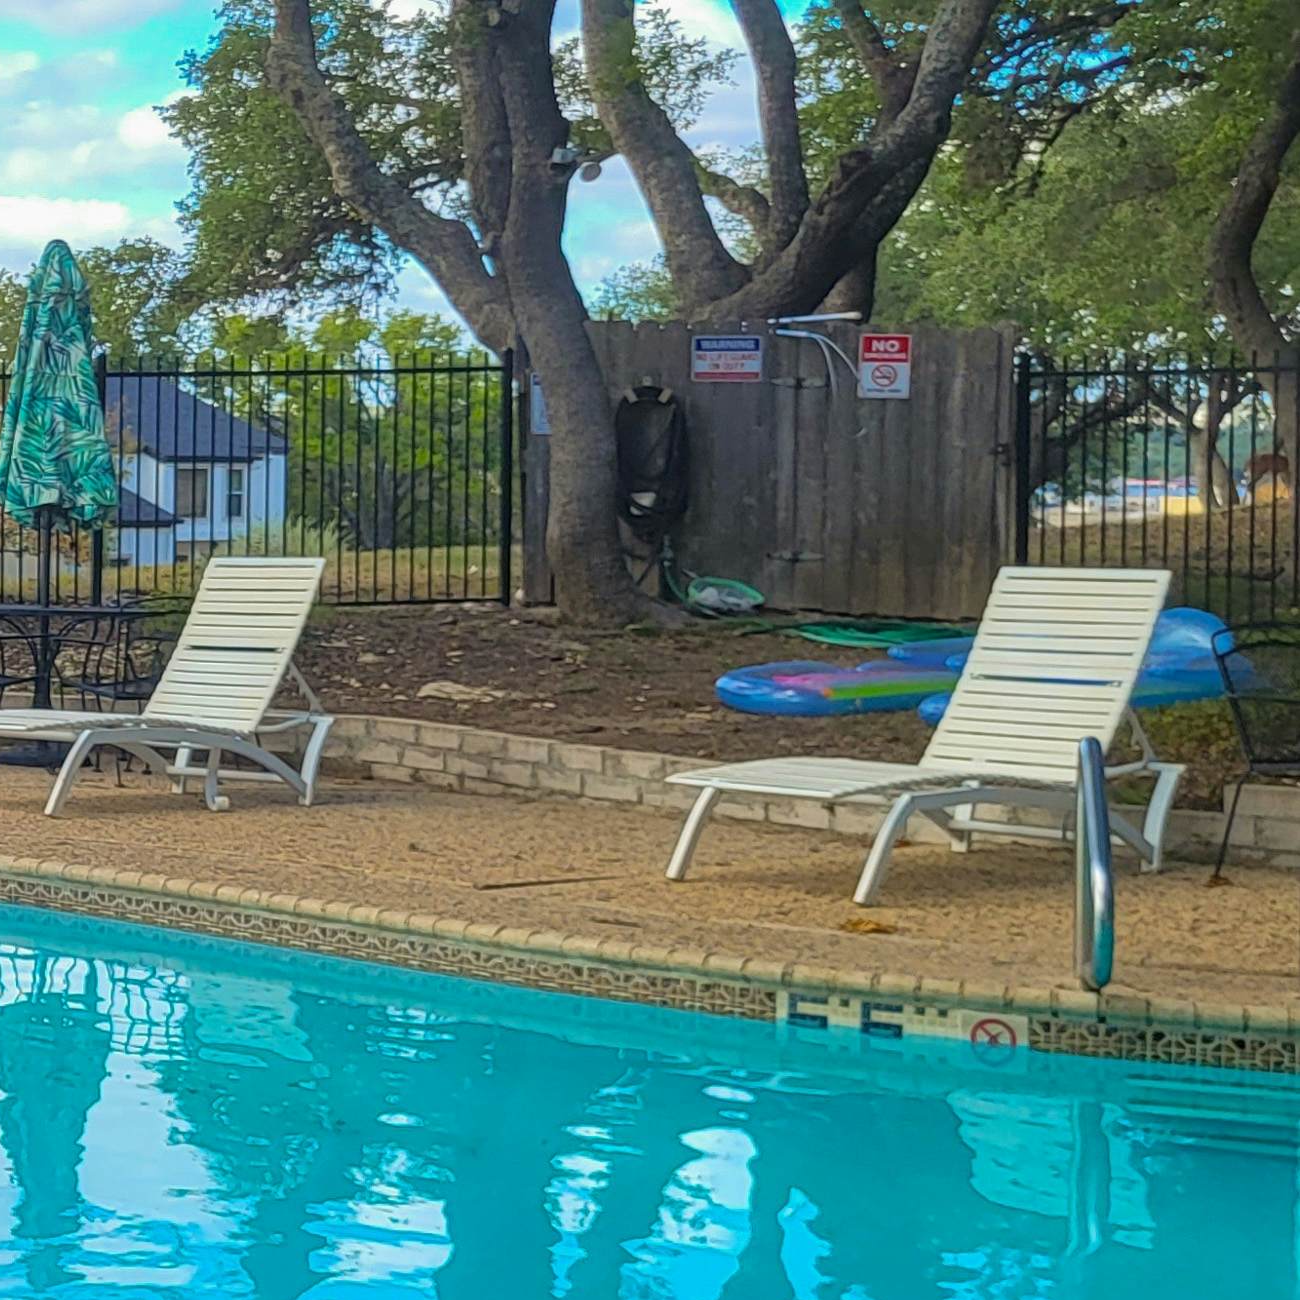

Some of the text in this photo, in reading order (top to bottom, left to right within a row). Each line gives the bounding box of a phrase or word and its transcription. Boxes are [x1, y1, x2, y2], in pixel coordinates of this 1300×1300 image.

[700, 340, 755, 350] WARNING
[872, 339, 900, 352] NO
[696, 353, 708, 361] NO
